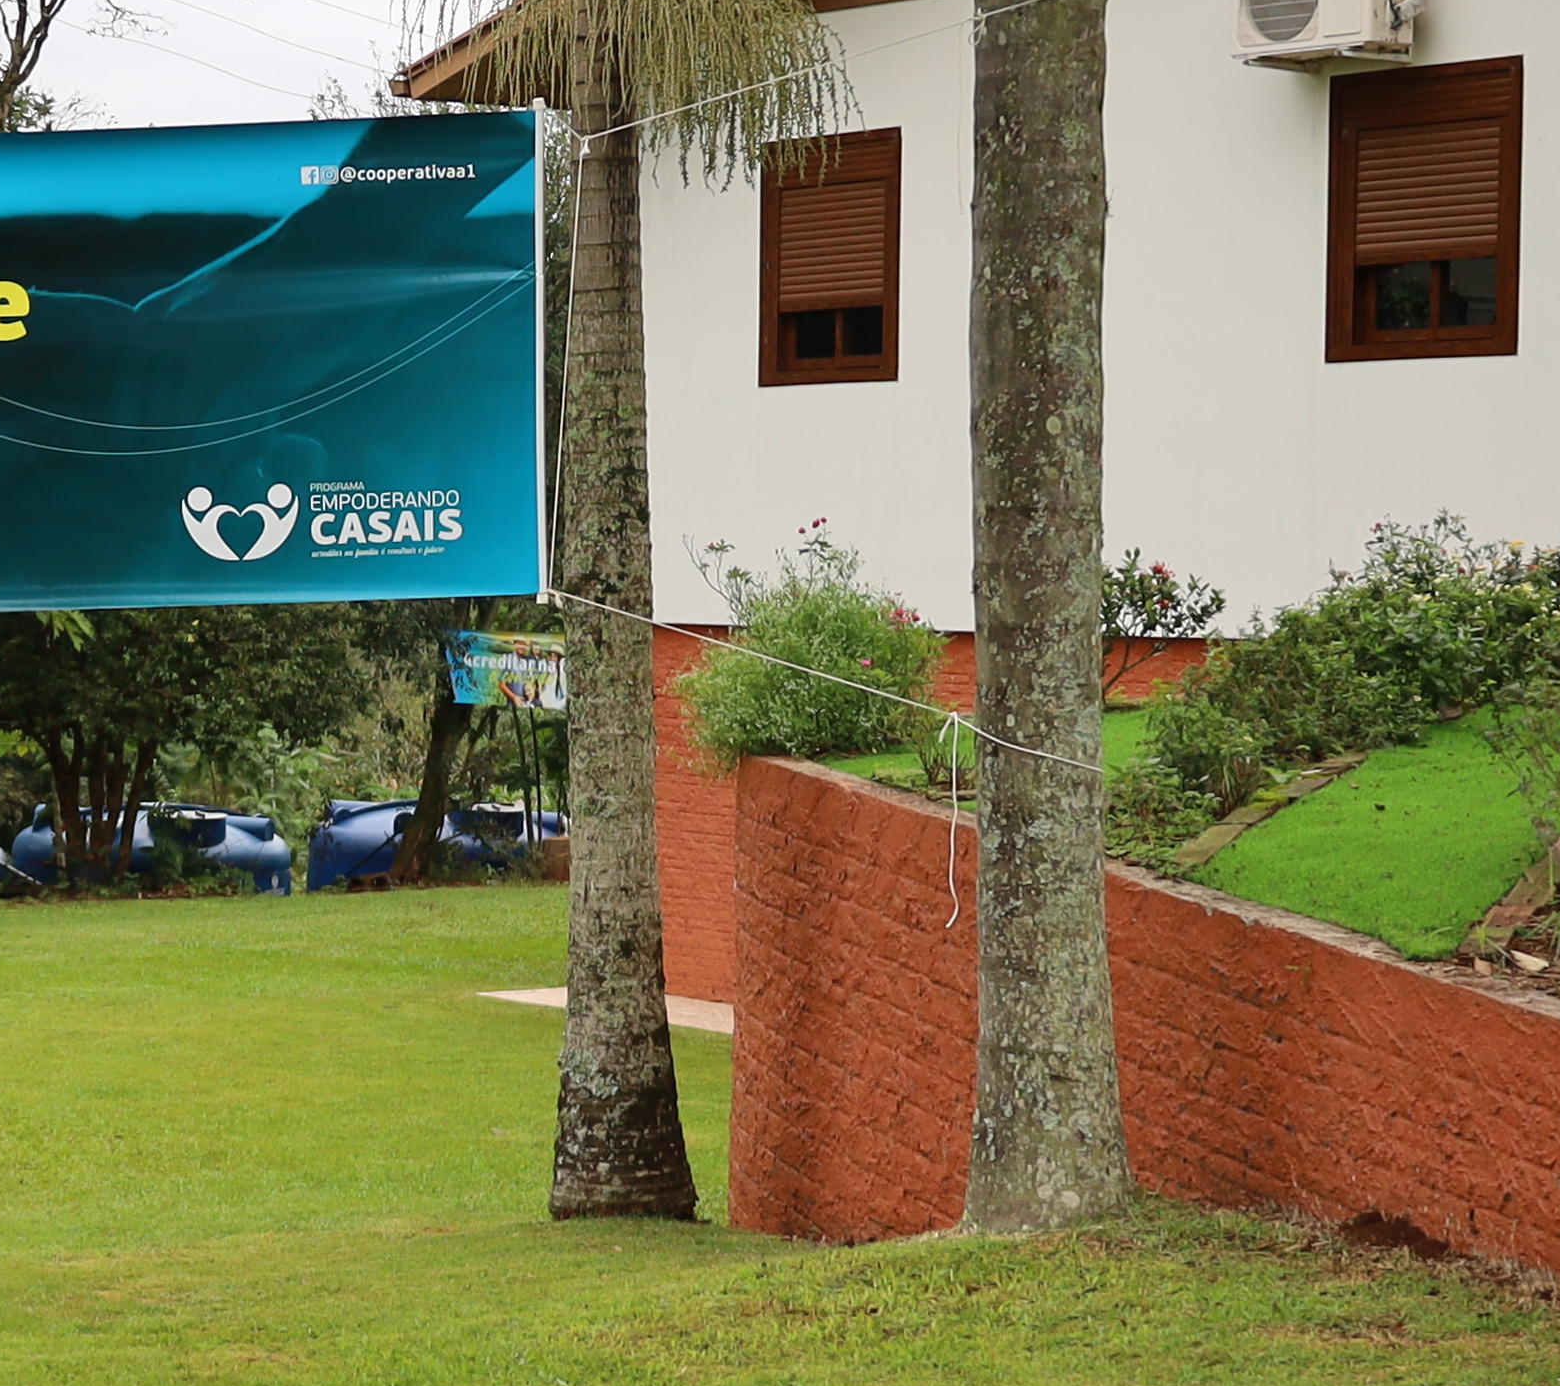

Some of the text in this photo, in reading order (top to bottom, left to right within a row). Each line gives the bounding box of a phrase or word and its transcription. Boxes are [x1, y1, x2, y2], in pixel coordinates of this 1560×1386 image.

[340, 164, 476, 184] @cooperativaa1
[309, 482, 365, 492] PROGRAMA
[310, 490, 460, 511] EMPODERANDO
[310, 509, 463, 545] CASAIS
